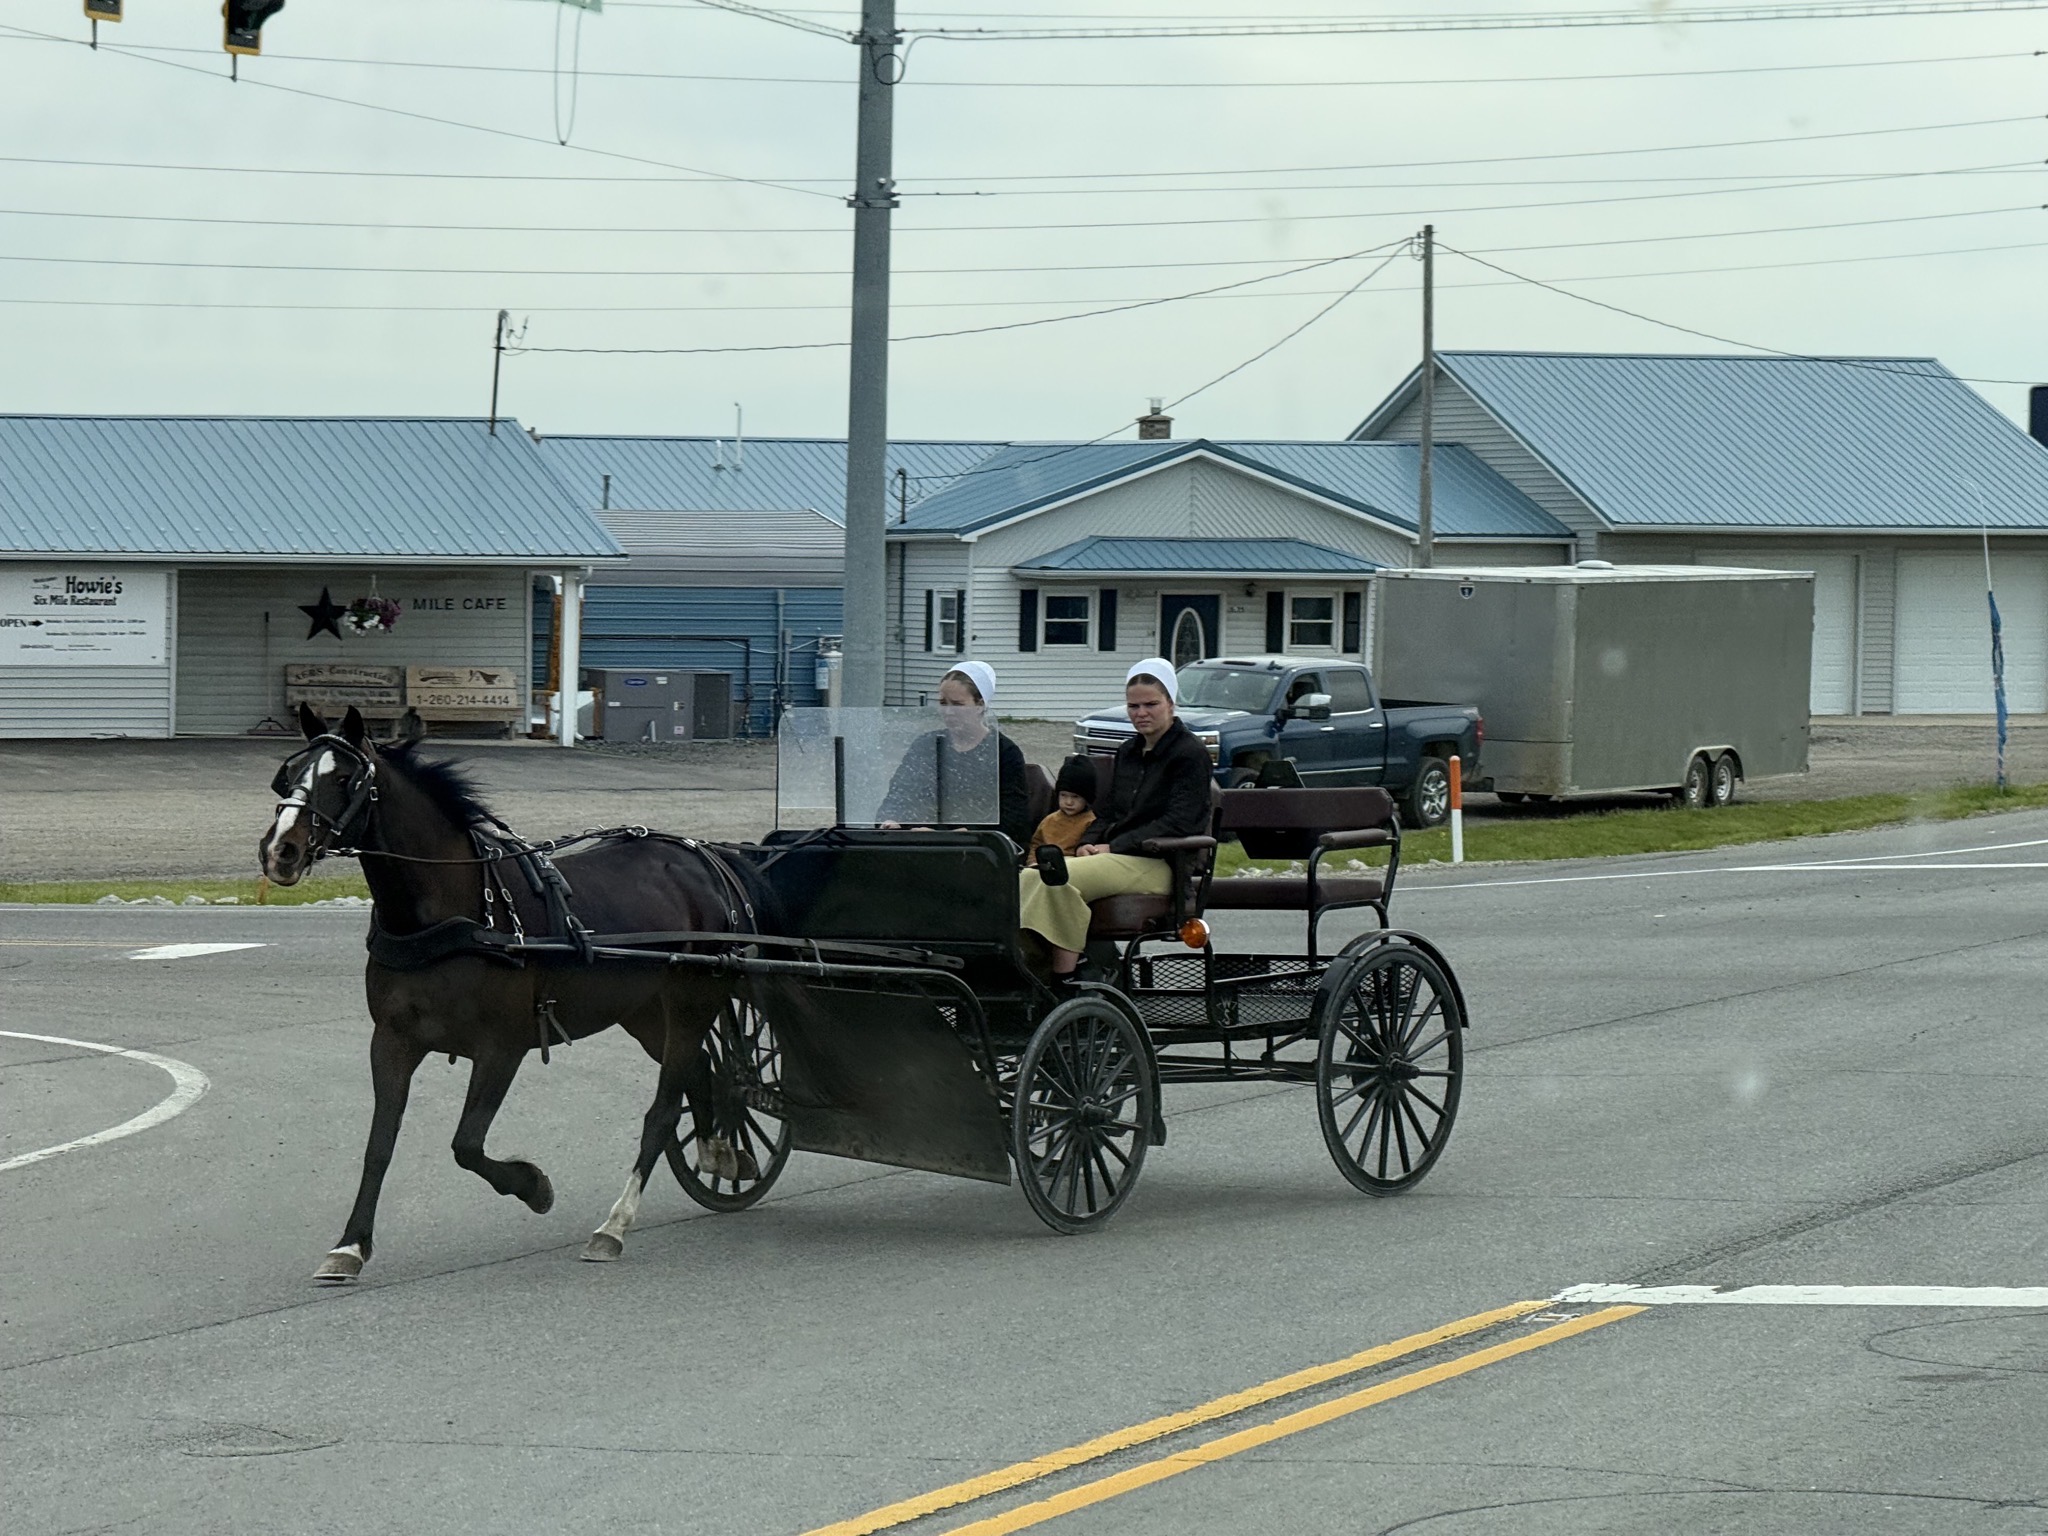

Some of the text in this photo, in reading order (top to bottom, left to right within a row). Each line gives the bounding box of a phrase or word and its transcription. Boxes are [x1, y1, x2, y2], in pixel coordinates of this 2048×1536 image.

[65, 576, 123, 594] Howie's
[412, 598, 455, 611] MILE
[462, 598, 507, 611] CAFE
[0, 618, 27, 628] OPEN
[416, 694, 510, 706] 1-260-214-4414
